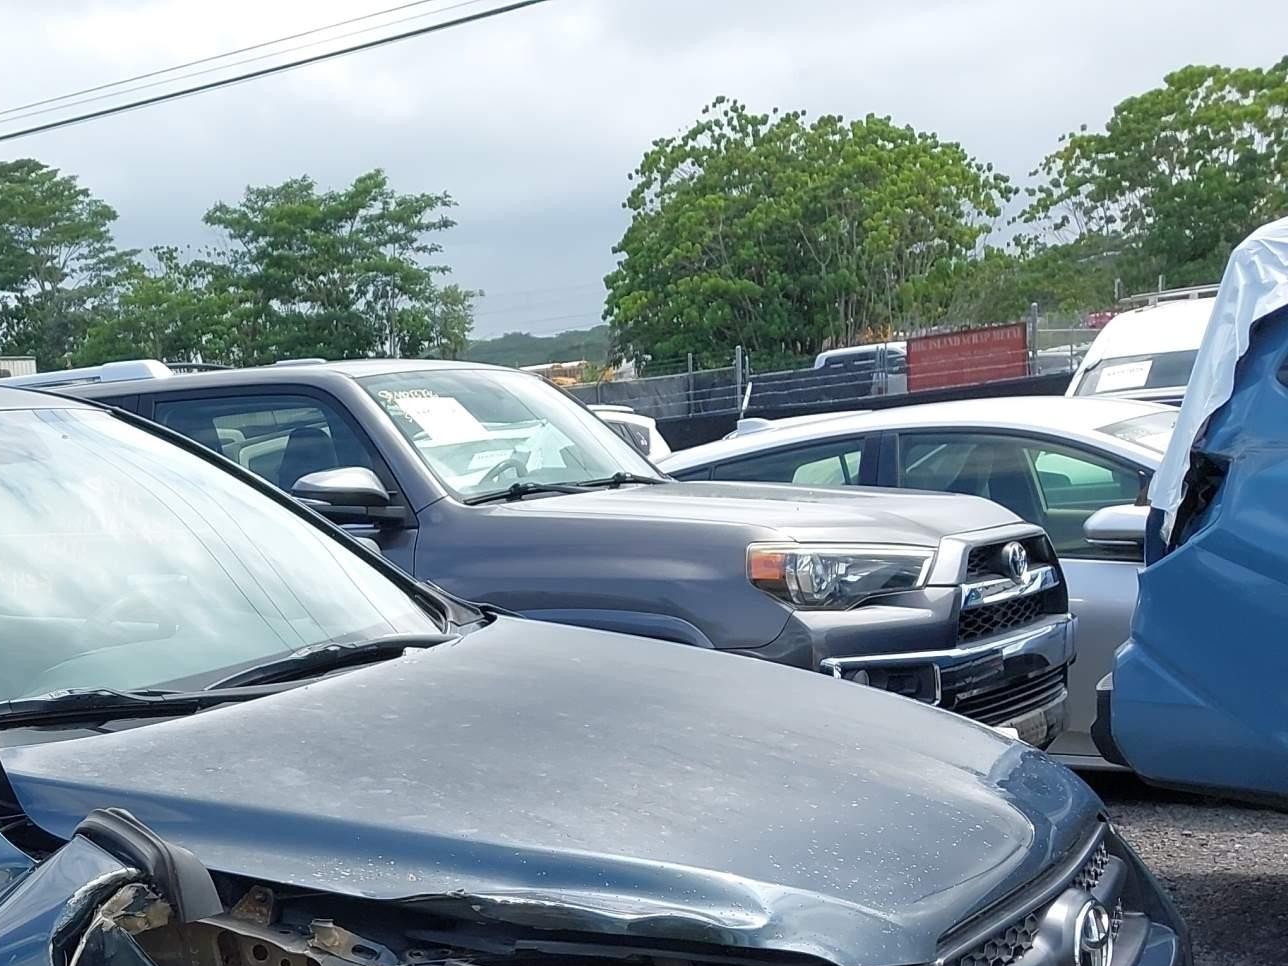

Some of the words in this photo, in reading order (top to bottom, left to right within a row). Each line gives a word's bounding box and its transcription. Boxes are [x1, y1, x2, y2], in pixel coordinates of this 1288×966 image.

[929, 336, 961, 350] ISLAND
[963, 331, 991, 345] SCRAP
[993, 326, 1021, 340] METAL
